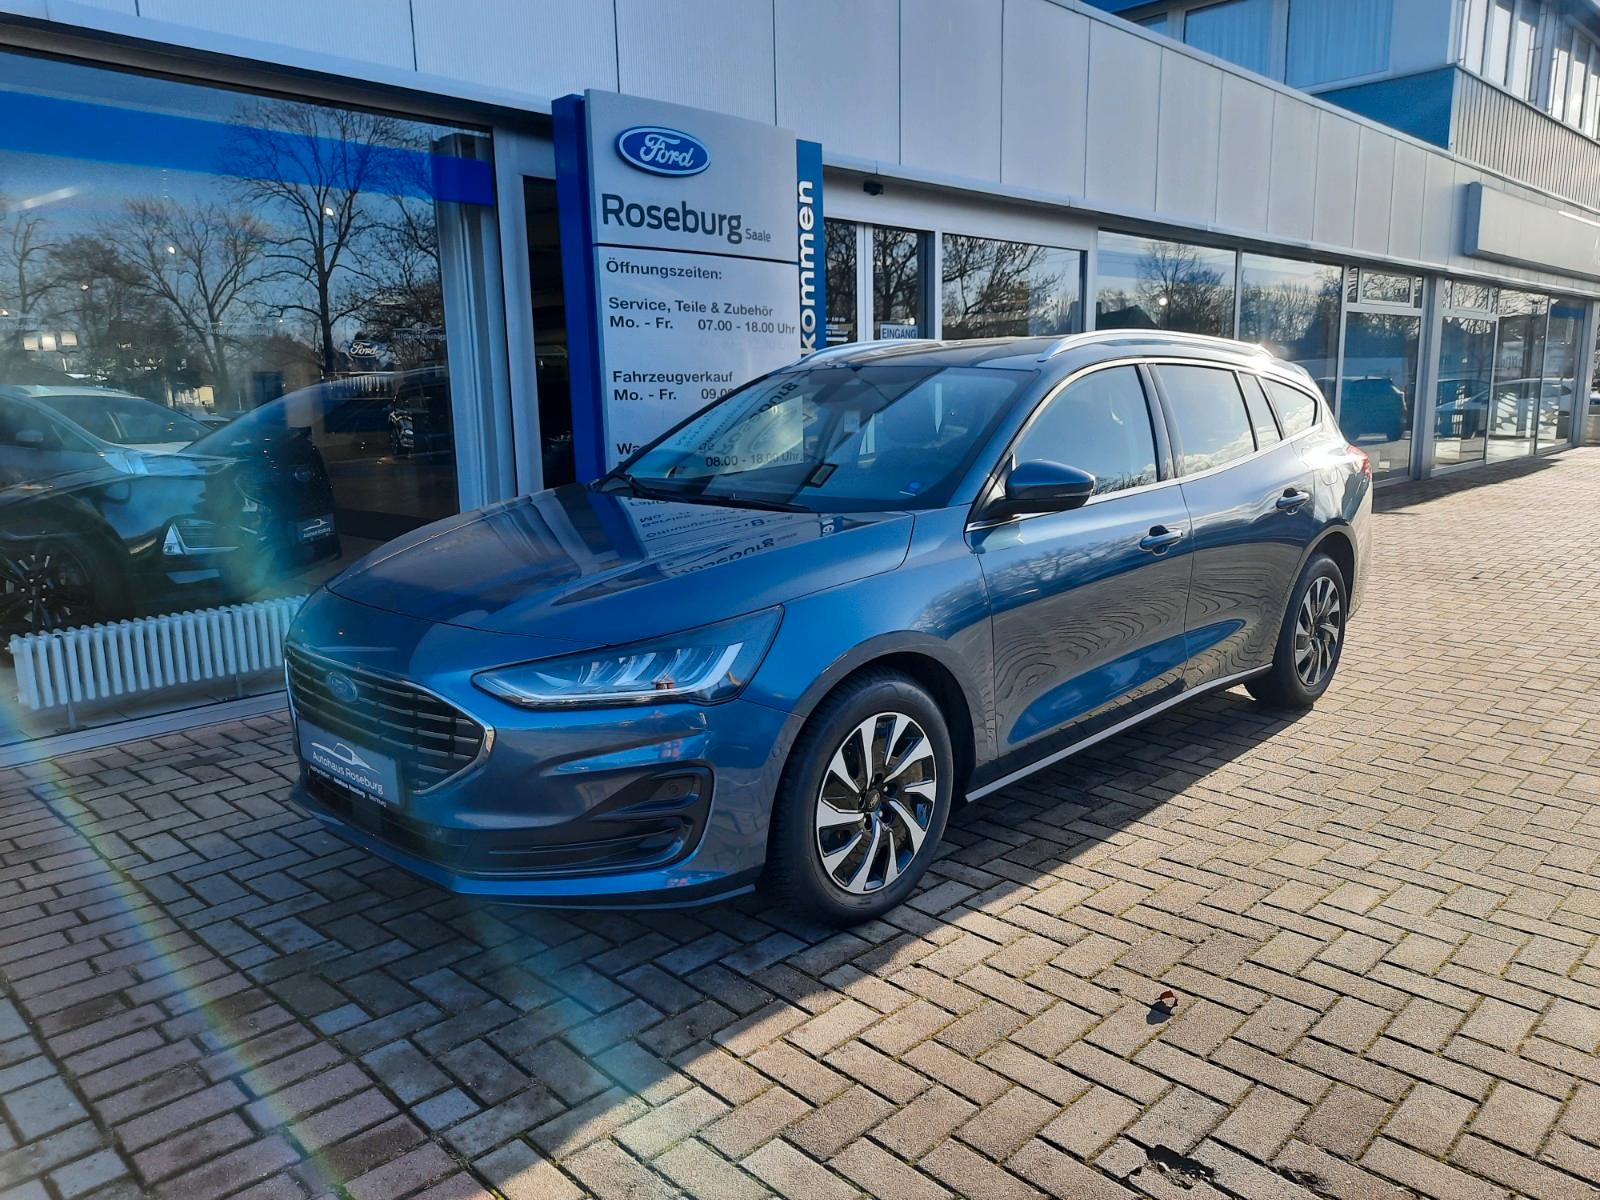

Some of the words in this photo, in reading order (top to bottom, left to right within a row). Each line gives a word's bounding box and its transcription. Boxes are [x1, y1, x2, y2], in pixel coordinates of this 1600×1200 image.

[640, 134, 694, 167] Ford
[601, 193, 742, 244] Roseburg
[745, 228, 772, 243] Saale
[606, 257, 723, 280] Öffnungszeiten:
[799, 180, 816, 354] kommen
[608, 297, 671, 313] Service,
[674, 300, 707, 313] Teile
[711, 302, 720, 314] &
[723, 303, 774, 318] Zubehör
[609, 315, 640, 329] Mo.
[655, 317, 673, 329] Fr.
[698, 319, 732, 332] 07.00
[745, 321, 774, 333] 18.00
[777, 323, 796, 334] Uhr
[882, 328, 917, 339] EINGANG
[350, 342, 377, 355] Ford
[613, 370, 733, 385] Fahrzeugverkauf
[613, 389, 643, 401] Mo.
[659, 388, 677, 400] Fr.
[312, 751, 345, 776] Autohaus
[345, 767, 384, 795] Roseburg
